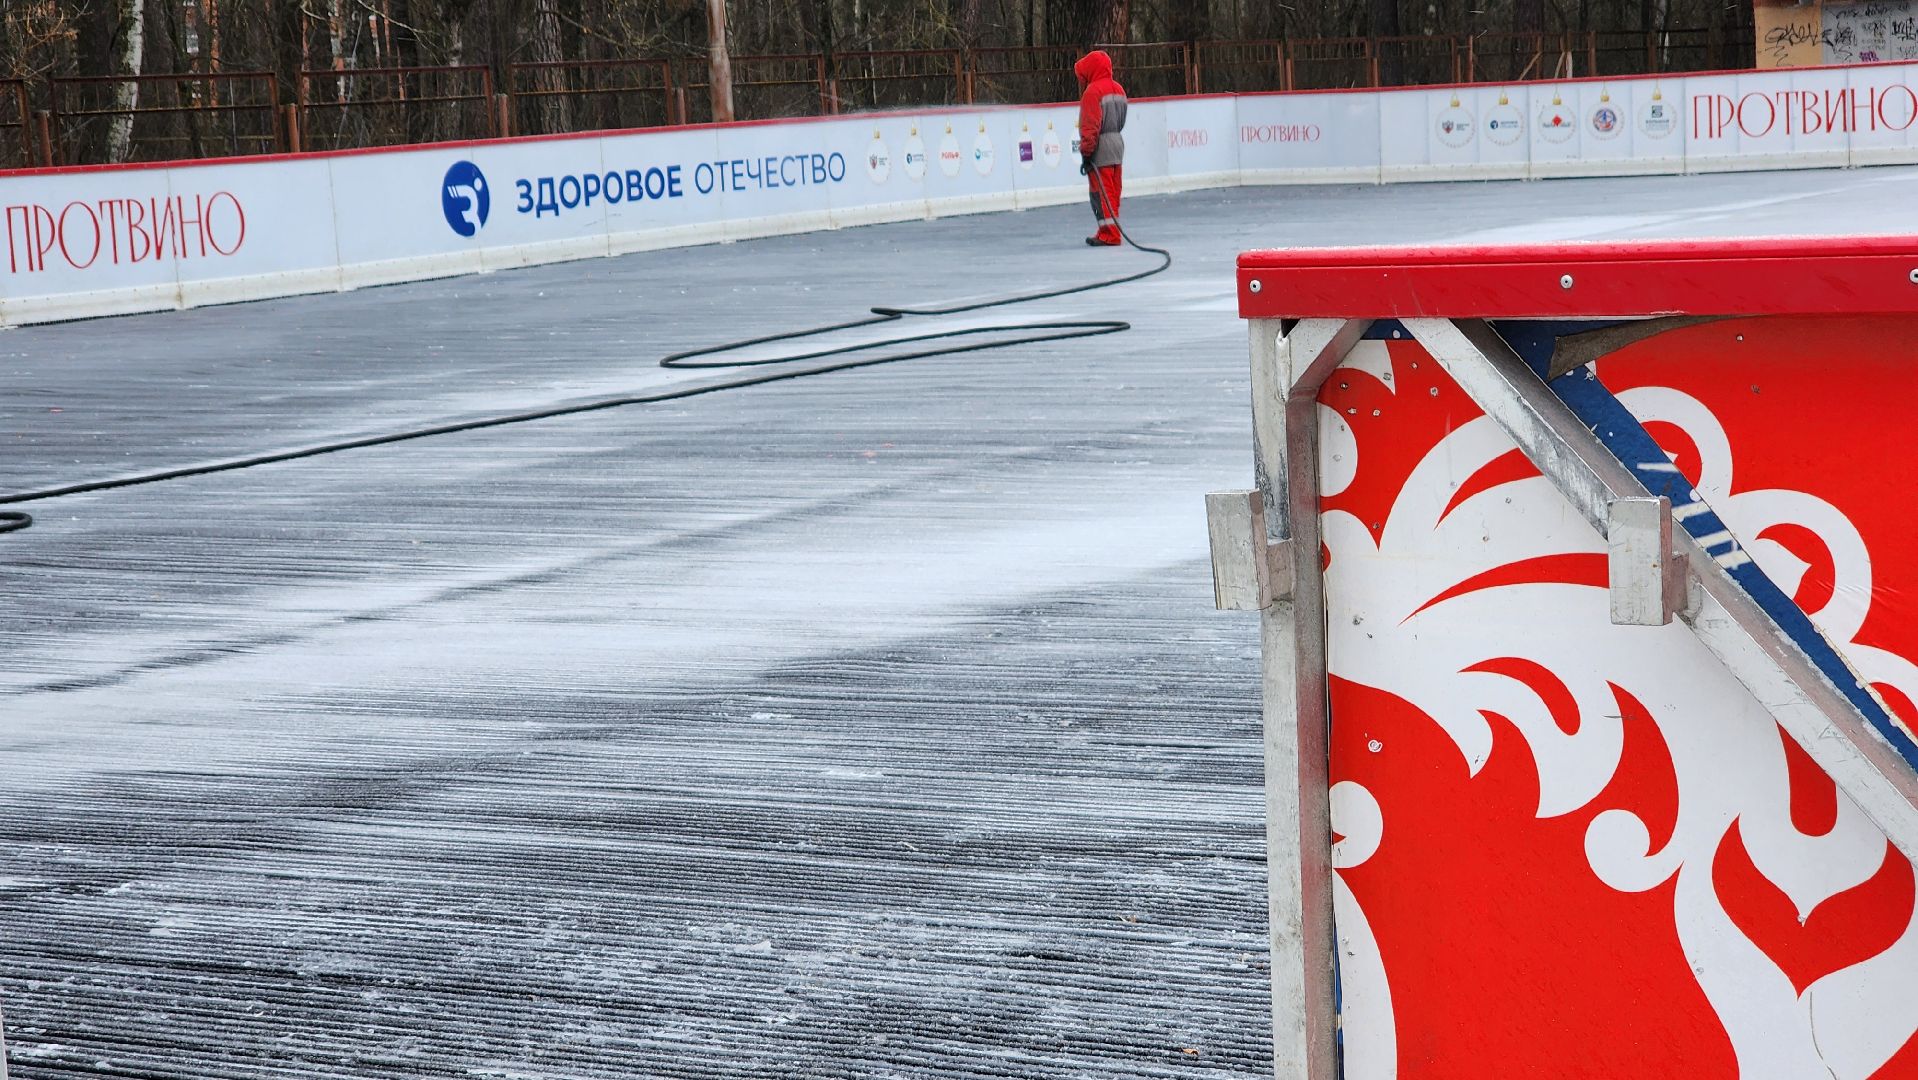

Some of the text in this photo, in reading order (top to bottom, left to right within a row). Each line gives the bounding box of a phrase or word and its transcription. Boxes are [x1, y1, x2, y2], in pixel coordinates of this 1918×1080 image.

[1167, 128, 1209, 148] ПРОТВИНО
[1241, 124, 1321, 144] ПРОТВИНО
[1693, 85, 1918, 139] ПРОТВИНО
[515, 151, 847, 219] ЗДОРОВОЕ ОТЕЧЕСТВО
[5, 191, 247, 274] ПРОТВИНО
